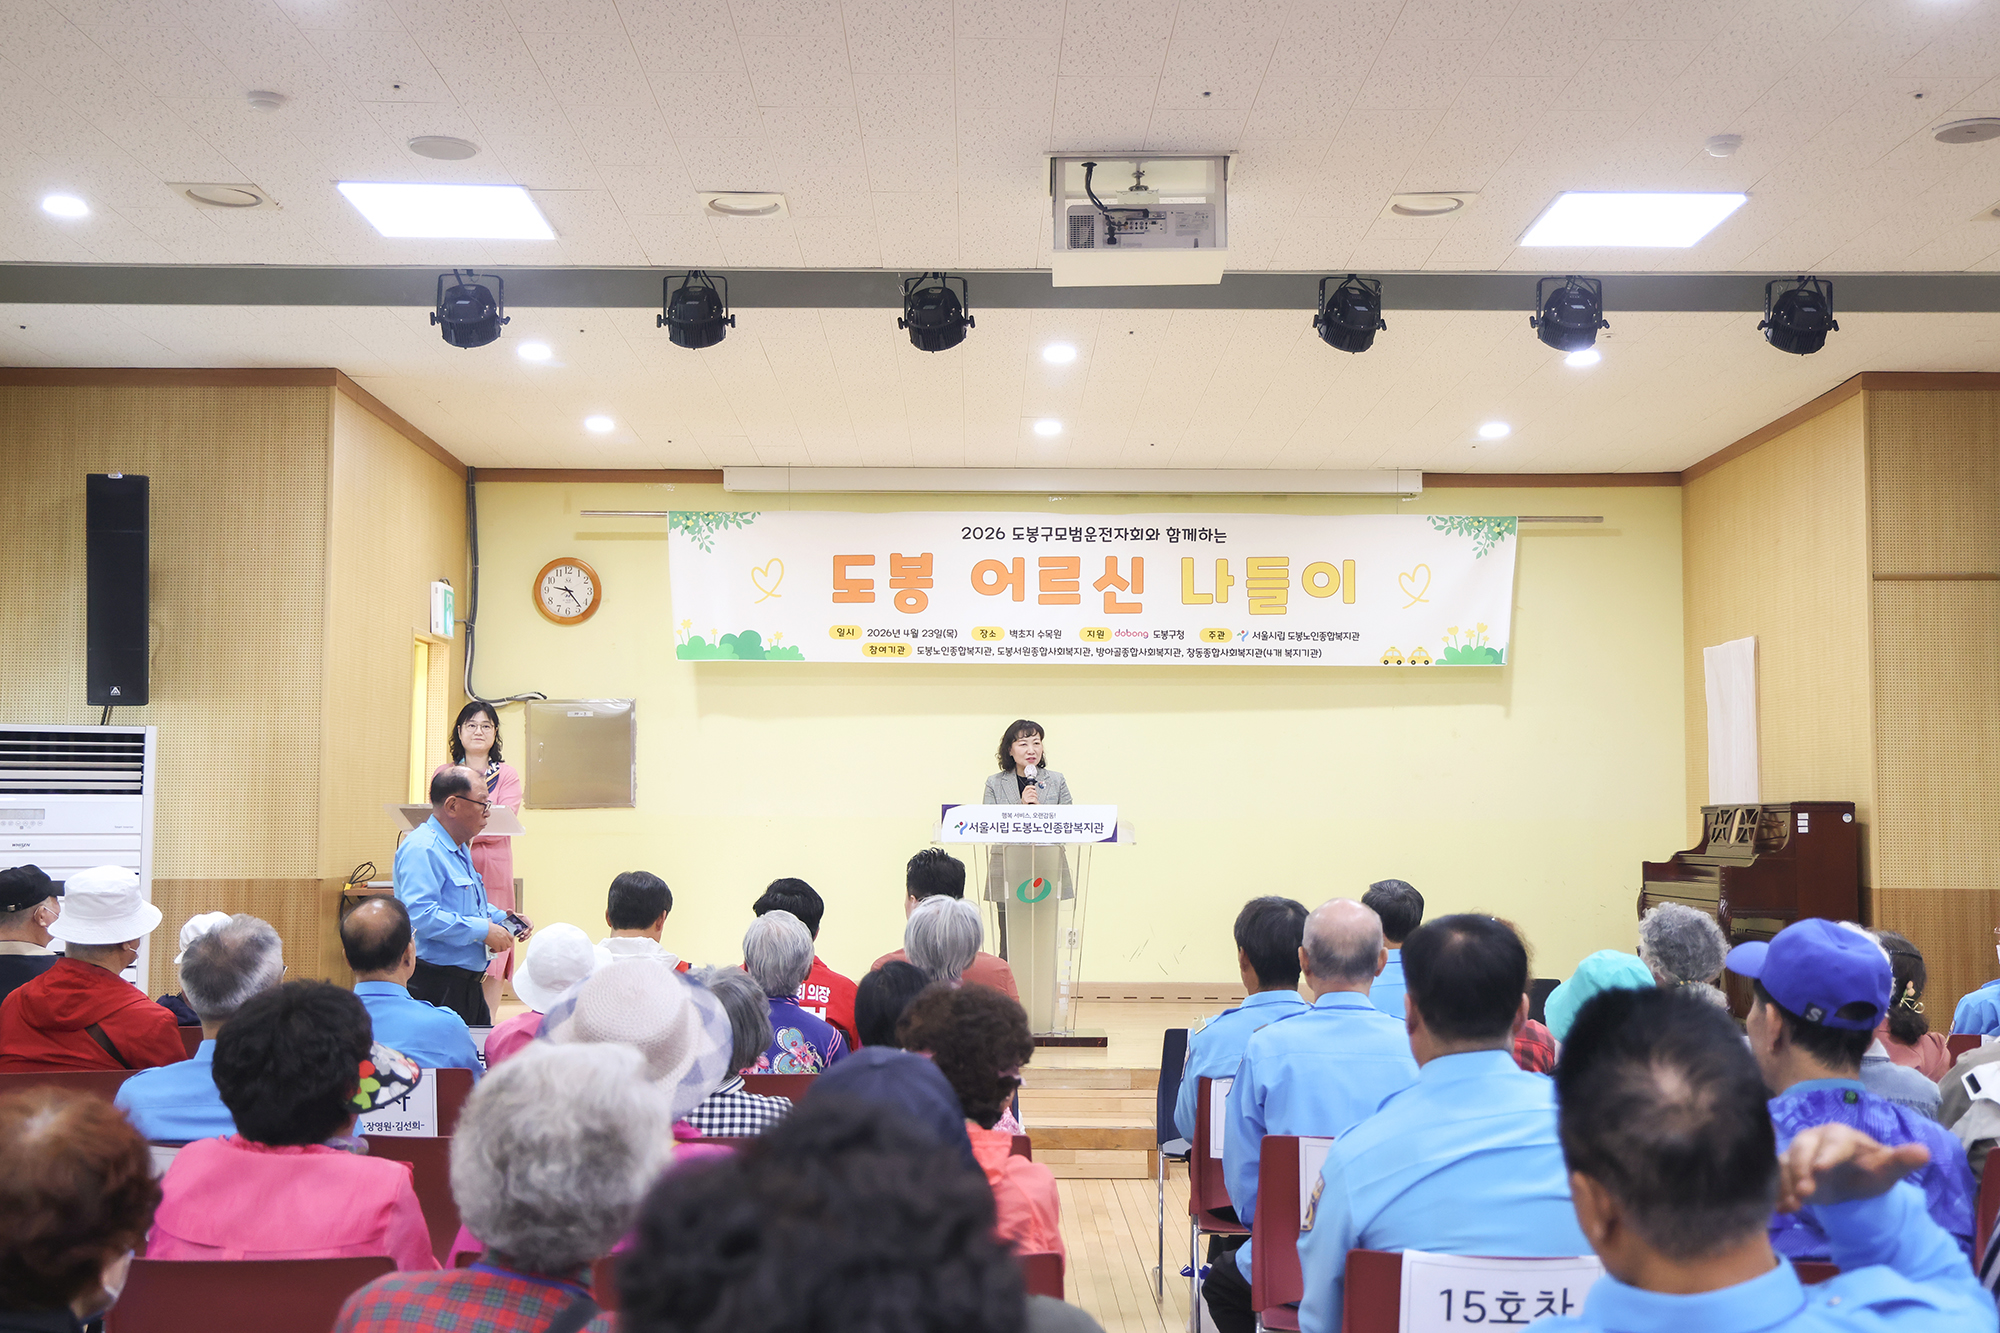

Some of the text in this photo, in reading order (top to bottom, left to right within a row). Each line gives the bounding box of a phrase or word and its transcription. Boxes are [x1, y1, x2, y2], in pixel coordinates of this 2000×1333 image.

[961, 526, 1228, 544] 2026 도봉구모범운전자회와 함께하는
[556, 569, 562, 577] 11
[564, 566, 573, 574] 12
[577, 569, 581, 577] 1
[547, 576, 555, 584] 10
[583, 576, 589, 584] 2
[832, 552, 1356, 616] 도봉 어르신 나들이
[544, 586, 550, 594] 9
[587, 587, 593, 596] 3
[547, 597, 553, 605] 8
[583, 598, 588, 606] 4
[556, 604, 562, 613] 7
[565, 608, 571, 616] 6
[836, 627, 855, 637] 일시
[866, 628, 901, 639] 2026년
[903, 628, 919, 639] 4월
[921, 628, 958, 639] 23일(목)
[980, 629, 996, 639] 장소
[1037, 628, 1062, 640] 수목원
[1087, 629, 1105, 639] 지원
[1114, 629, 1149, 639] dobong
[1153, 629, 1185, 641] 도봉구청
[1208, 630, 1225, 640] 주관
[1251, 630, 1286, 642] 서울시립
[1287, 630, 1360, 642] 도봉노인종합복지관
[869, 645, 1322, 659] 참여기관 도봉노인종합복지관, 도봉서원종합사회복지관, 방아골종합사회복지관, 창동종합사회복지관(4개 복지기관)
[1001, 812, 1013, 820] 행복
[968, 821, 1105, 835] 서울시립 도봉노인종합복지관
[807, 983, 831, 1004] 의장
[1806, 1007, 1823, 1022] S
[1439, 1287, 1575, 1325] 15호차
